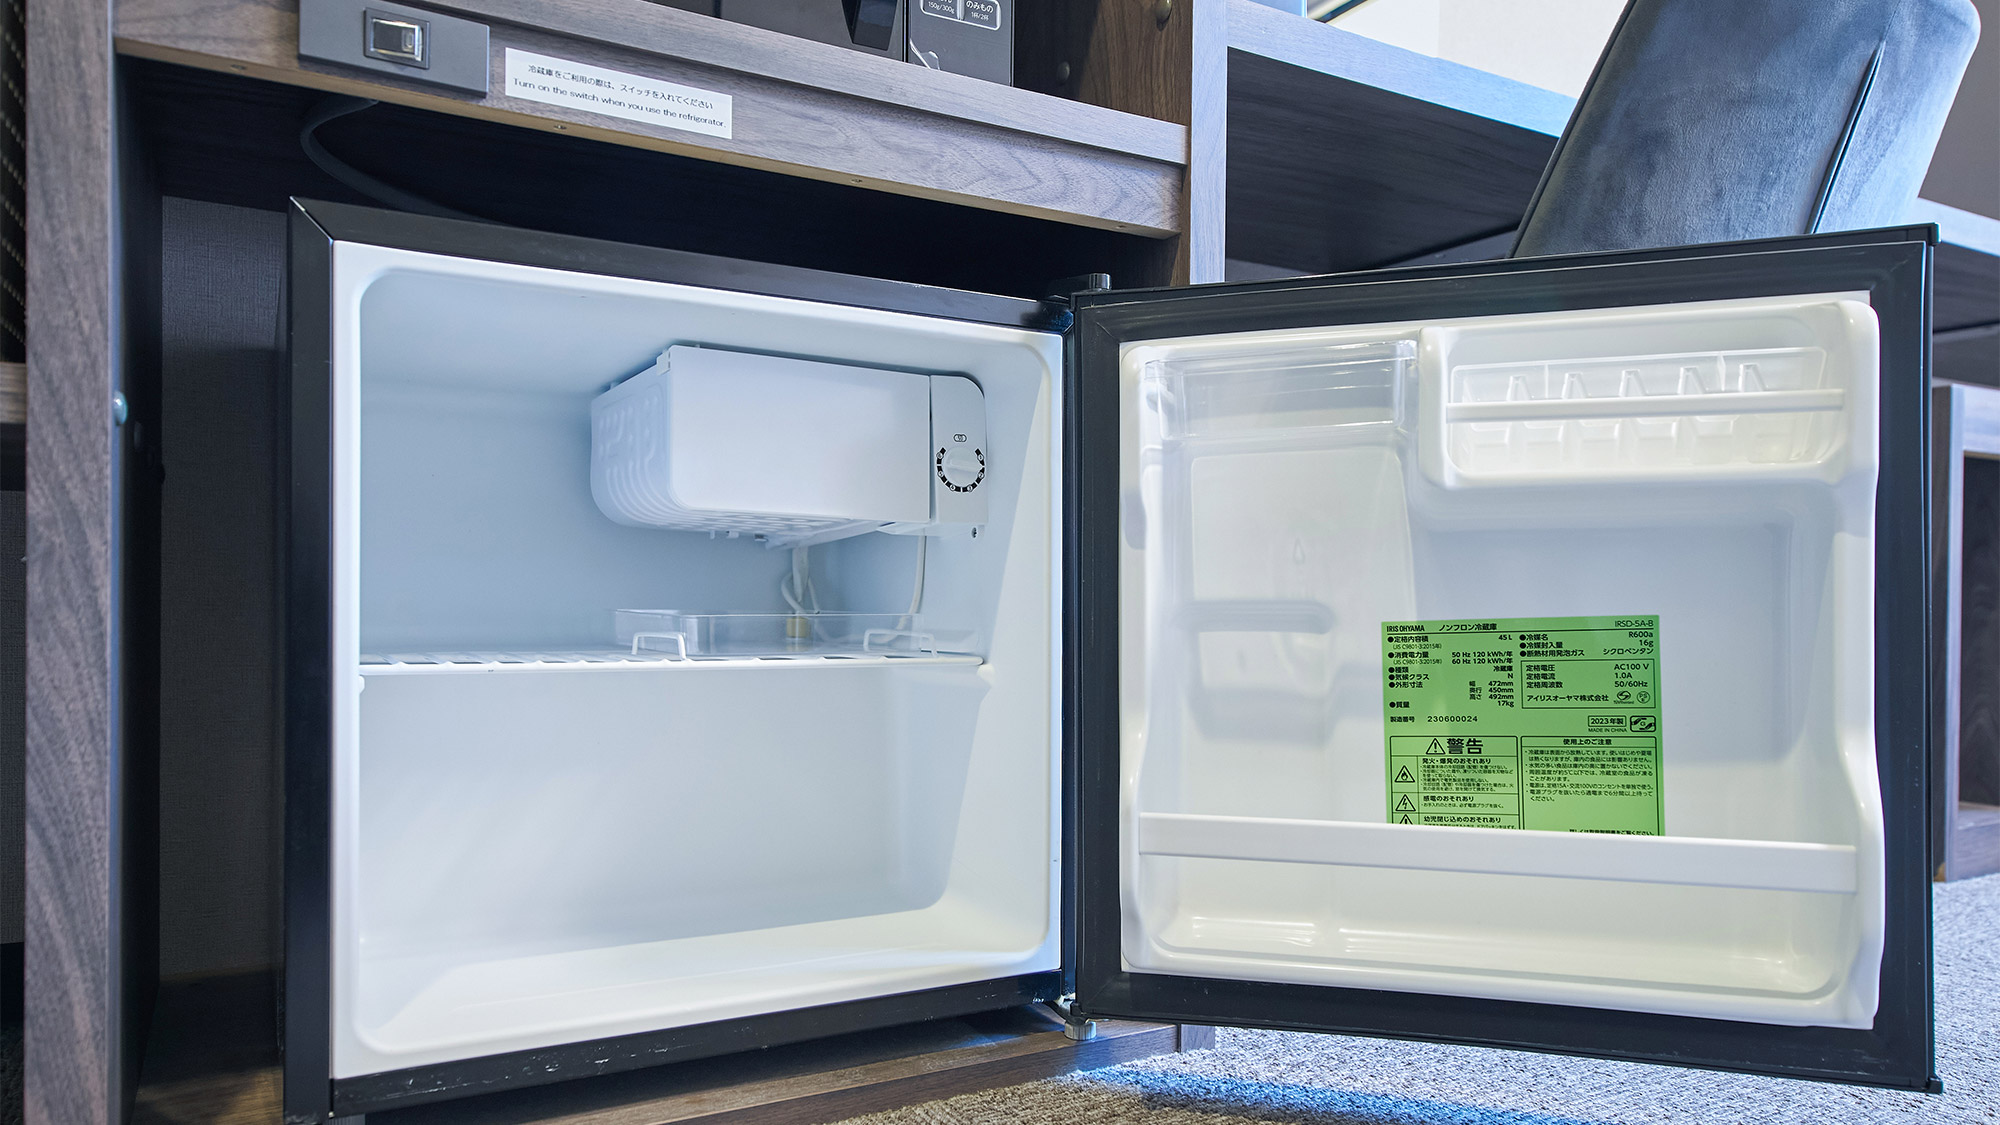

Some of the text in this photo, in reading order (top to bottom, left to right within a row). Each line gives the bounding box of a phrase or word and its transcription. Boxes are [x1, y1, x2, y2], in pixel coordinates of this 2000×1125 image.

[928, 2, 954, 14] 150g/300g
[966, 0, 993, 13] のみもの
[528, 64, 713, 109] 冷蔵庫をご利用の際は、スイッチを入れてください
[513, 78, 726, 128] Turn on the switch when you use the refrigerator.
[1447, 738, 1483, 754] 警告
